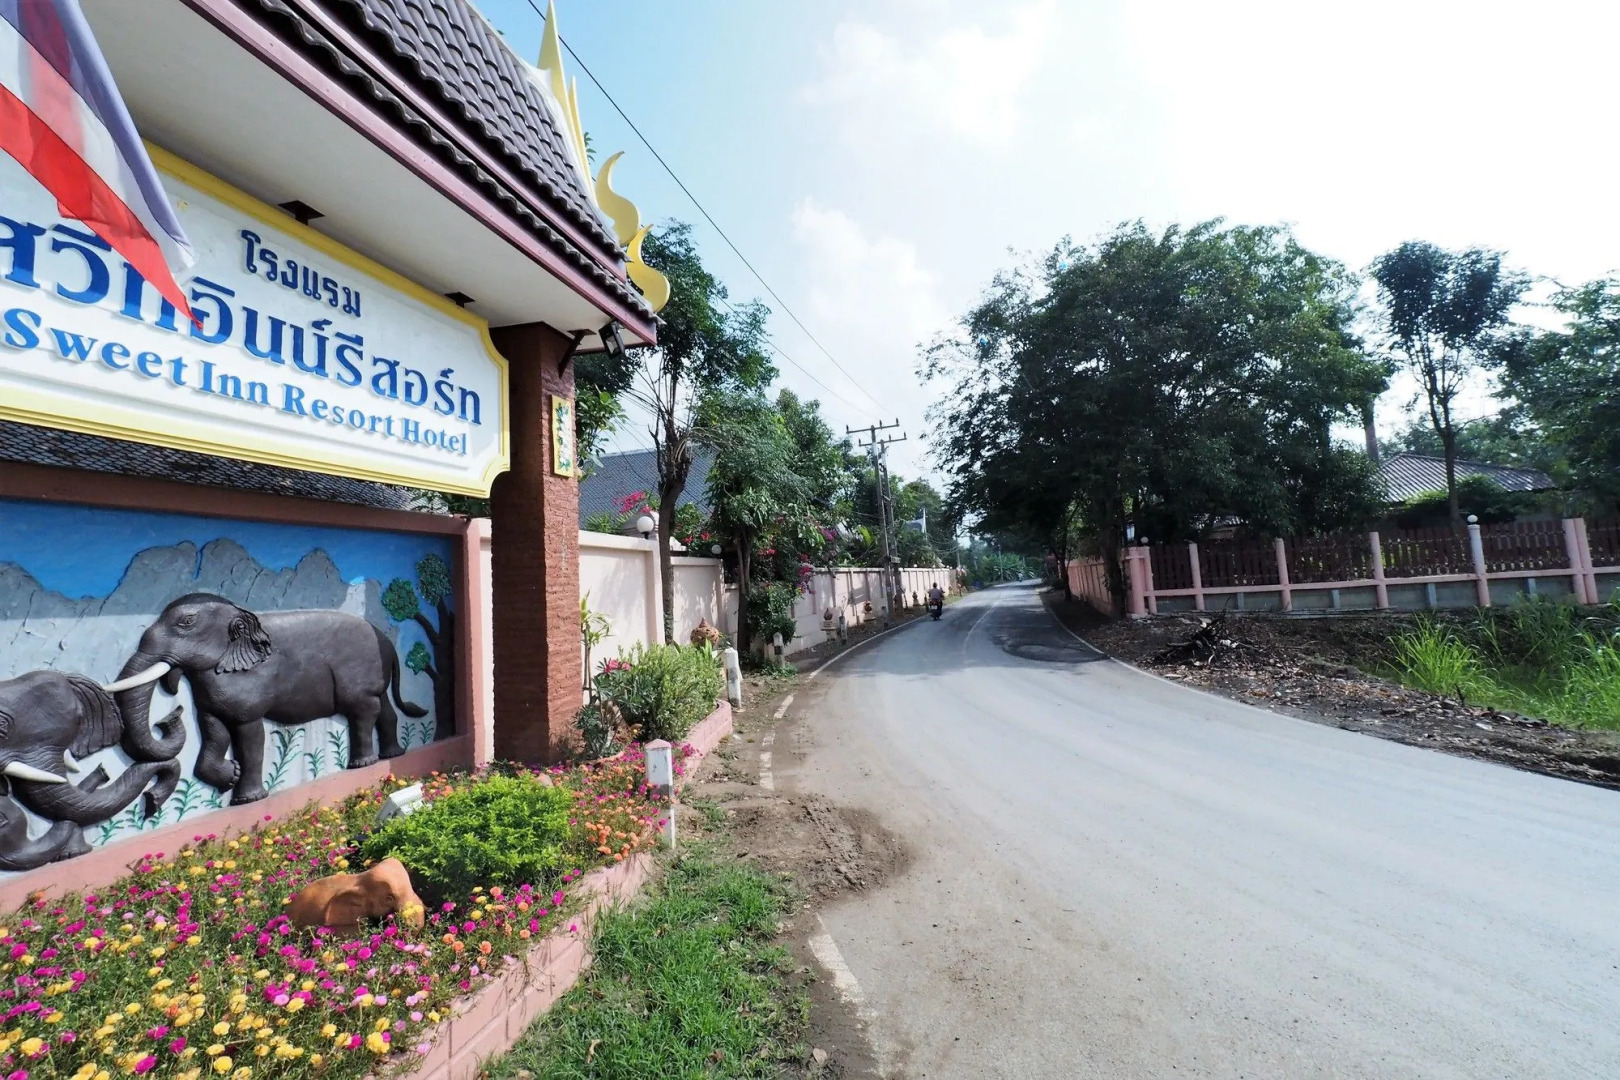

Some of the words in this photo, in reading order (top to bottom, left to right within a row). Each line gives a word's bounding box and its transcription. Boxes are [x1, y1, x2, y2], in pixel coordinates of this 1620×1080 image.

[241, 229, 362, 318] โรงแรม
[4, 307, 188, 387] Sweet
[200, 360, 271, 407] Inn
[282, 382, 395, 437] Resort
[402, 417, 468, 456] Hotel
